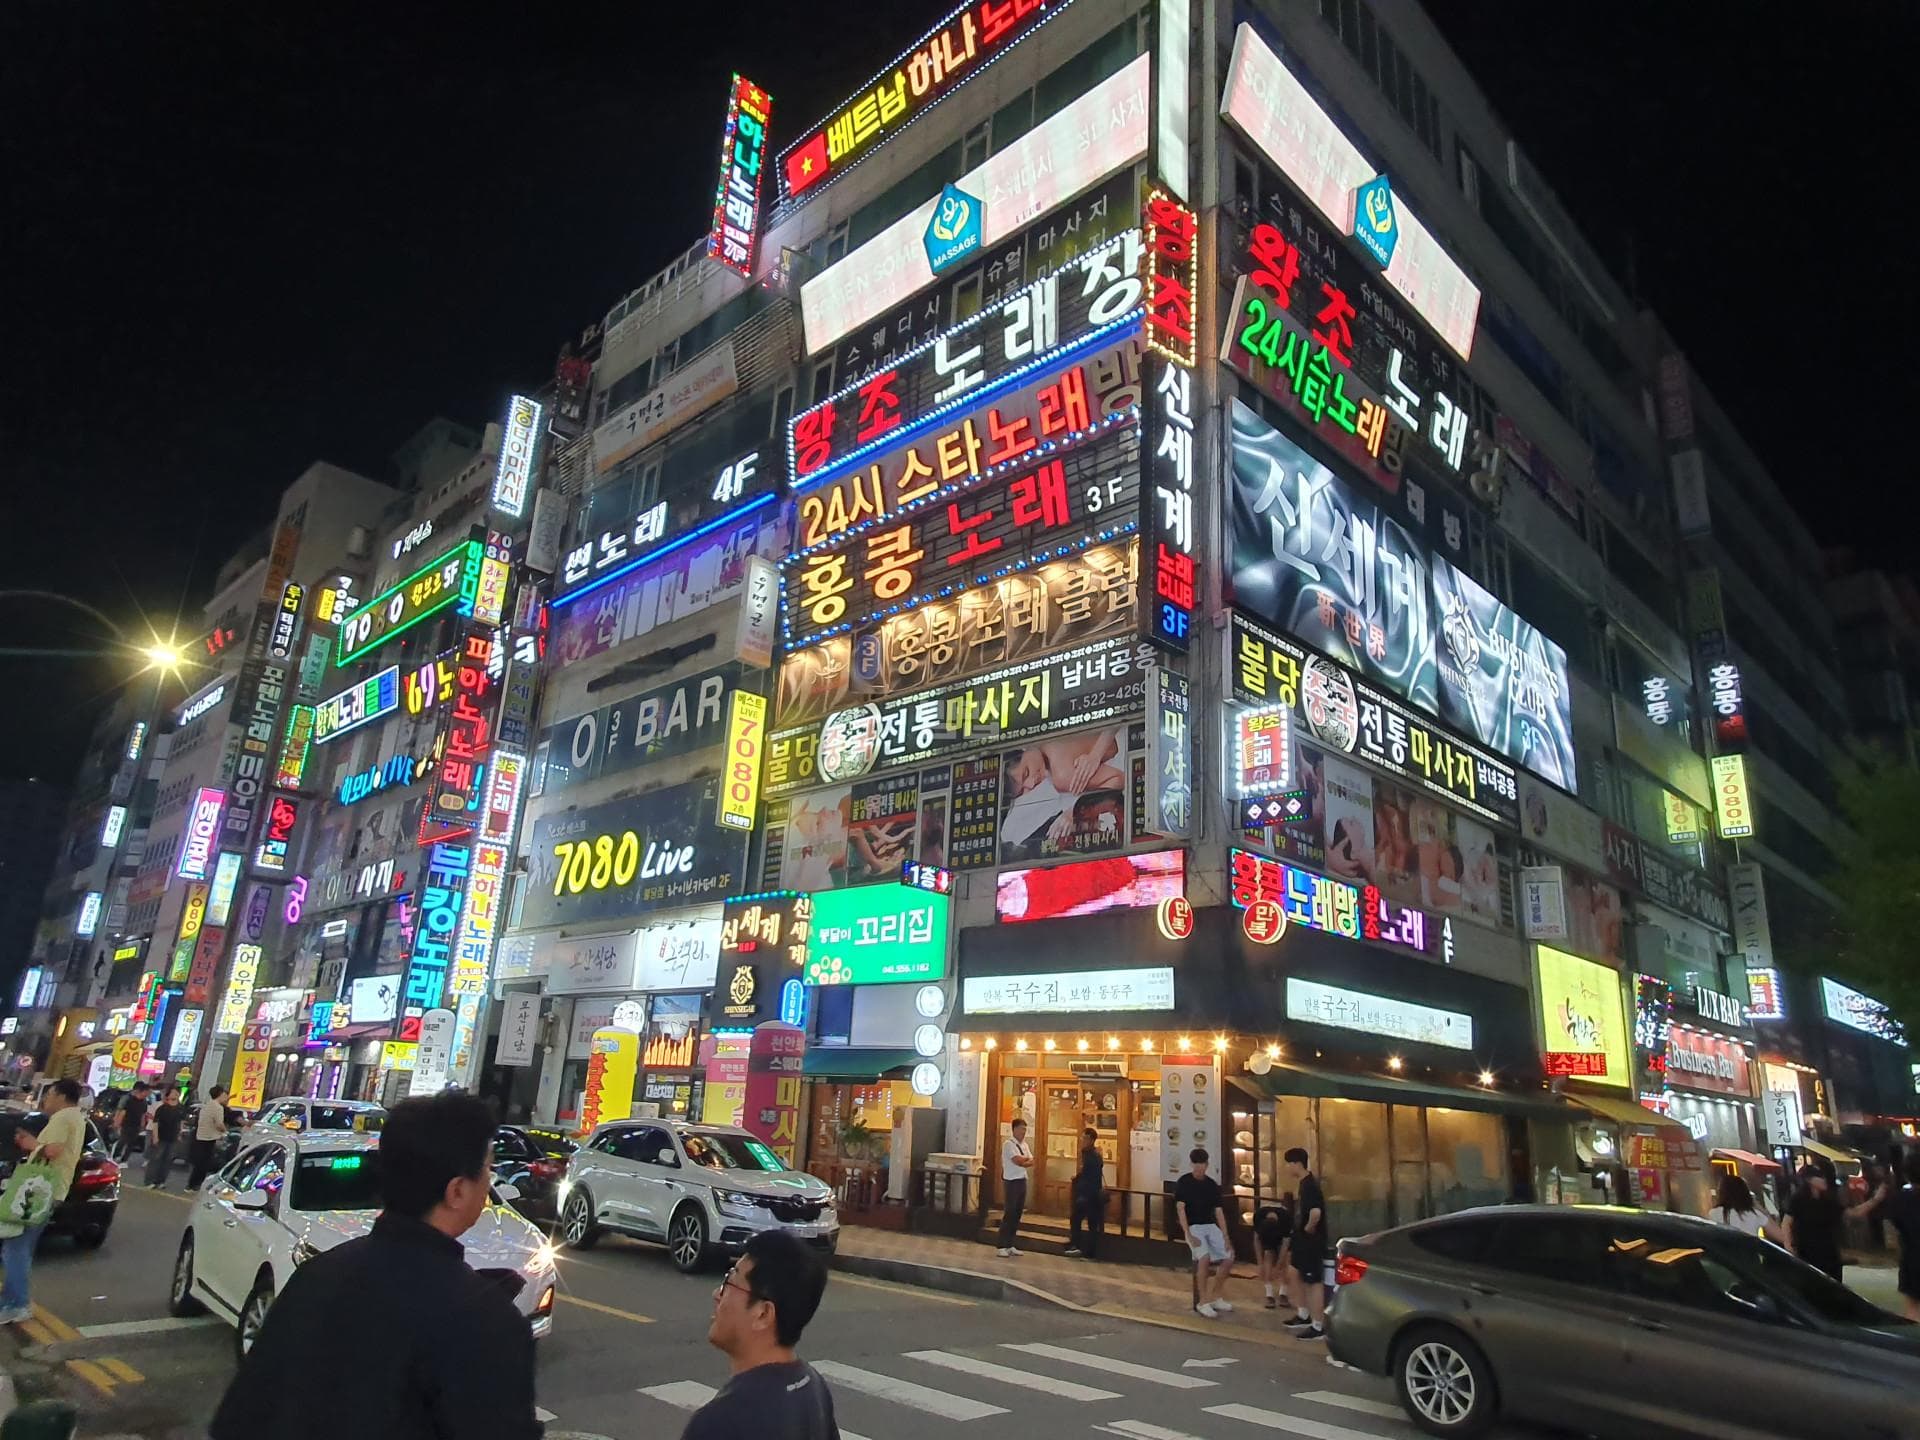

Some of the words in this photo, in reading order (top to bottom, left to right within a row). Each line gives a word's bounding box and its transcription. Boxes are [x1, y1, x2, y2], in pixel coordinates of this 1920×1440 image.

[828, 71, 907, 162] 베트남
[908, 12, 976, 97] 하나
[735, 114, 765, 176] 하나
[725, 167, 756, 231] 노래
[932, 233, 978, 268] MASSAGE
[1355, 223, 1390, 264] MASSAGE
[846, 295, 942, 363] 스웨디시
[986, 247, 1024, 283] 슈얼
[1037, 194, 1109, 250] 마사지
[934, 227, 1147, 404] 노래장
[1239, 299, 1310, 393] 24시
[713, 452, 760, 502] 4F
[1157, 362, 1194, 555] 신세계
[803, 464, 886, 547] 24시
[897, 418, 983, 505] 스타
[486, 546, 510, 563] 80
[488, 531, 512, 548] 70
[800, 525, 925, 625] 홍콩
[946, 459, 1071, 566] 노래
[1086, 476, 1124, 514] 3F
[1253, 455, 1432, 657] 신세계
[442, 559, 461, 589] 5F
[1158, 543, 1194, 586] 노래
[1157, 571, 1194, 611] CLUB
[892, 616, 960, 675] 홍콩
[970, 586, 1049, 648] 노래
[1055, 560, 1140, 626] 클럽
[1161, 605, 1188, 639] 3F
[1317, 590, 1387, 661] 新世界
[453, 636, 493, 722] 피아노
[861, 641, 876, 673] 3F
[1487, 626, 1560, 702] BUSINESS
[339, 685, 365, 729] 노래
[607, 709, 622, 755] 3F
[634, 674, 725, 747] BAR
[740, 707, 759, 720] LIVE
[767, 731, 818, 783] 불당
[823, 721, 878, 772] 중국
[881, 699, 941, 753] 전통
[946, 670, 1050, 738] 마사지
[1061, 643, 1158, 691] 남녀공용
[1236, 632, 1301, 709] 불당
[1304, 668, 1356, 730] 중국
[1360, 697, 1408, 766] 전통
[1409, 724, 1475, 800] 마사지
[1477, 761, 1517, 801] 남녀공용
[1508, 674, 1547, 721] CLUB
[1253, 731, 1273, 766] 노래
[1519, 718, 1541, 751] 3F
[379, 755, 416, 788] LIVE
[441, 729, 475, 791] 노래
[731, 717, 759, 802] 7080
[1163, 708, 1187, 829] 마사지
[492, 774, 515, 812] 노래
[1714, 772, 1744, 820] 7080
[554, 829, 640, 897] 7080
[641, 839, 694, 879] Live
[667, 873, 717, 897] 라이브카페
[718, 873, 731, 889] 2F
[910, 865, 937, 889] 1층
[185, 885, 208, 933] 7080
[470, 879, 496, 919] 하나
[1172, 902, 1188, 932] 만복
[1249, 904, 1276, 937] 만복
[1286, 869, 1358, 941] 노래방
[1380, 898, 1424, 951] 노래
[461, 919, 486, 964] 노래
[720, 904, 781, 950] 신세계
[787, 897, 810, 967] 신세계
[853, 905, 934, 946] 꼬리집
[231, 950, 257, 1006] 어우동
[407, 929, 449, 1009] 노래
[460, 978, 478, 991] 7F
[1004, 979, 1060, 1005] 국수집
[1321, 993, 1361, 1024] 국수집
[1696, 985, 1720, 1021] LUX
[1719, 993, 1741, 1027] BAR
[118, 1039, 140, 1050] 70
[243, 1037, 269, 1049] 80
[246, 1025, 271, 1037] 70
[121, 1052, 140, 1064] 80
[1554, 1055, 1602, 1075] 소갈비
[1670, 1039, 1717, 1076] Business
[1690, 1112, 1708, 1140] BAR
